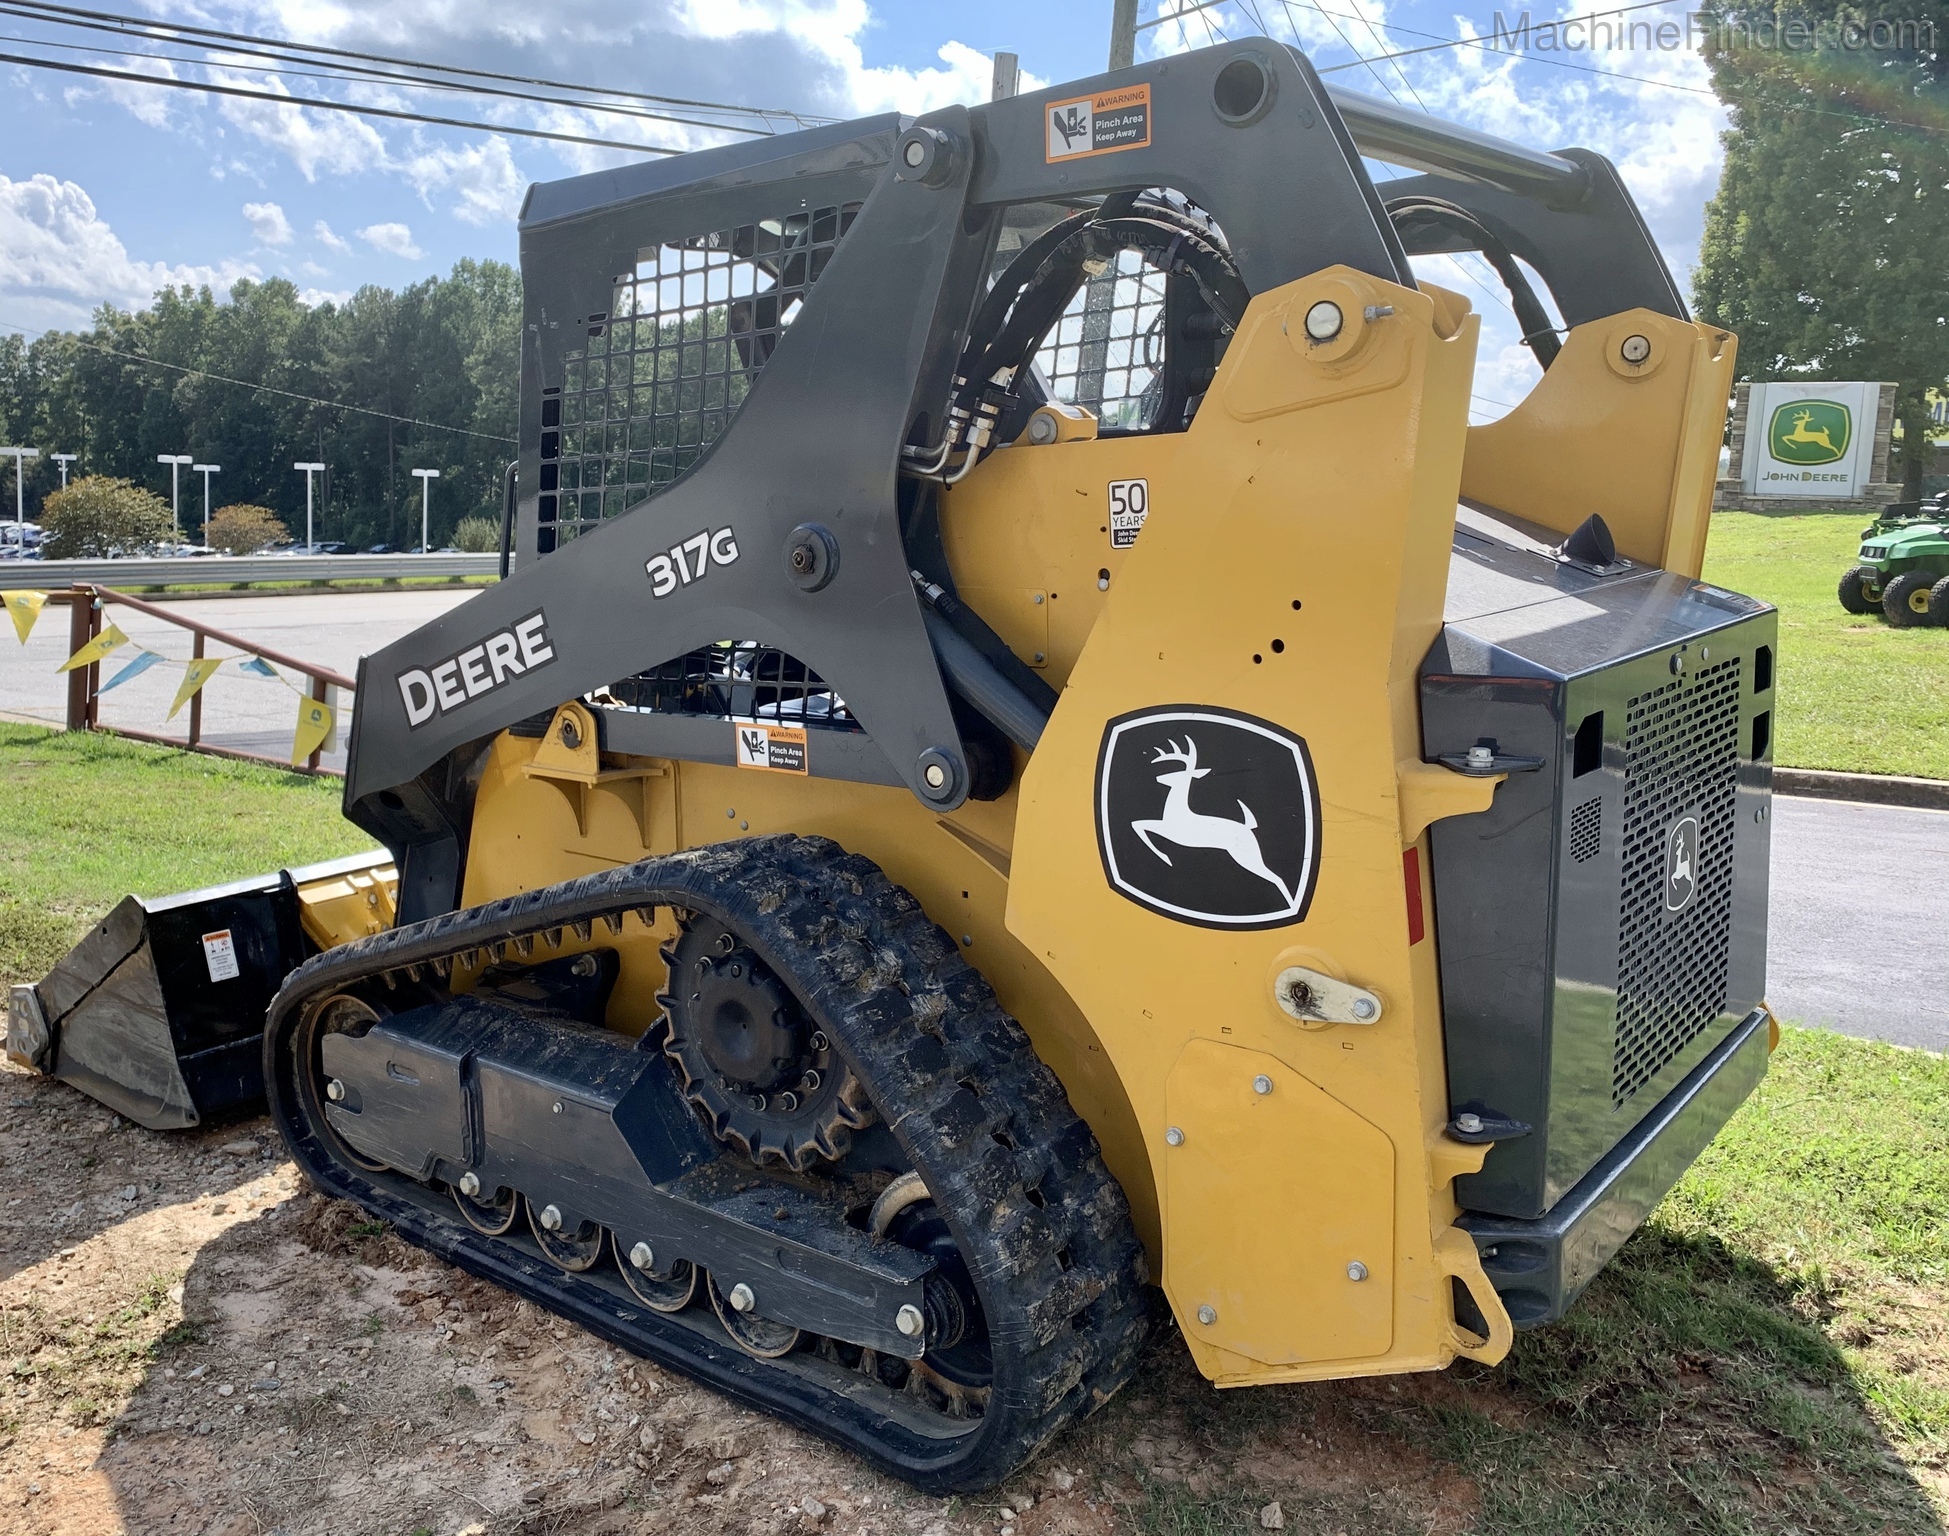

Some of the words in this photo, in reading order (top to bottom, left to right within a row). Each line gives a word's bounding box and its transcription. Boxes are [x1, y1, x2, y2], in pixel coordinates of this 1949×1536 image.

[1105, 91, 1145, 106] WARNING
[1095, 118, 1120, 130] Pinch
[1122, 114, 1143, 125] Area
[1095, 132, 1115, 142] Keep
[1116, 128, 1137, 138] Away
[1762, 471, 1799, 481] JOHN
[1801, 472, 1848, 482] DEERE
[1111, 483, 1146, 515] 50
[1112, 515, 1146, 528] YEARS
[645, 526, 740, 598] 317G
[397, 613, 554, 727] DEERE
[776, 731, 803, 740] WARNING
[770, 746, 787, 755] Pinch
[788, 748, 803, 757] Area
[770, 756, 784, 765] Keep
[785, 757, 799, 767] Away
